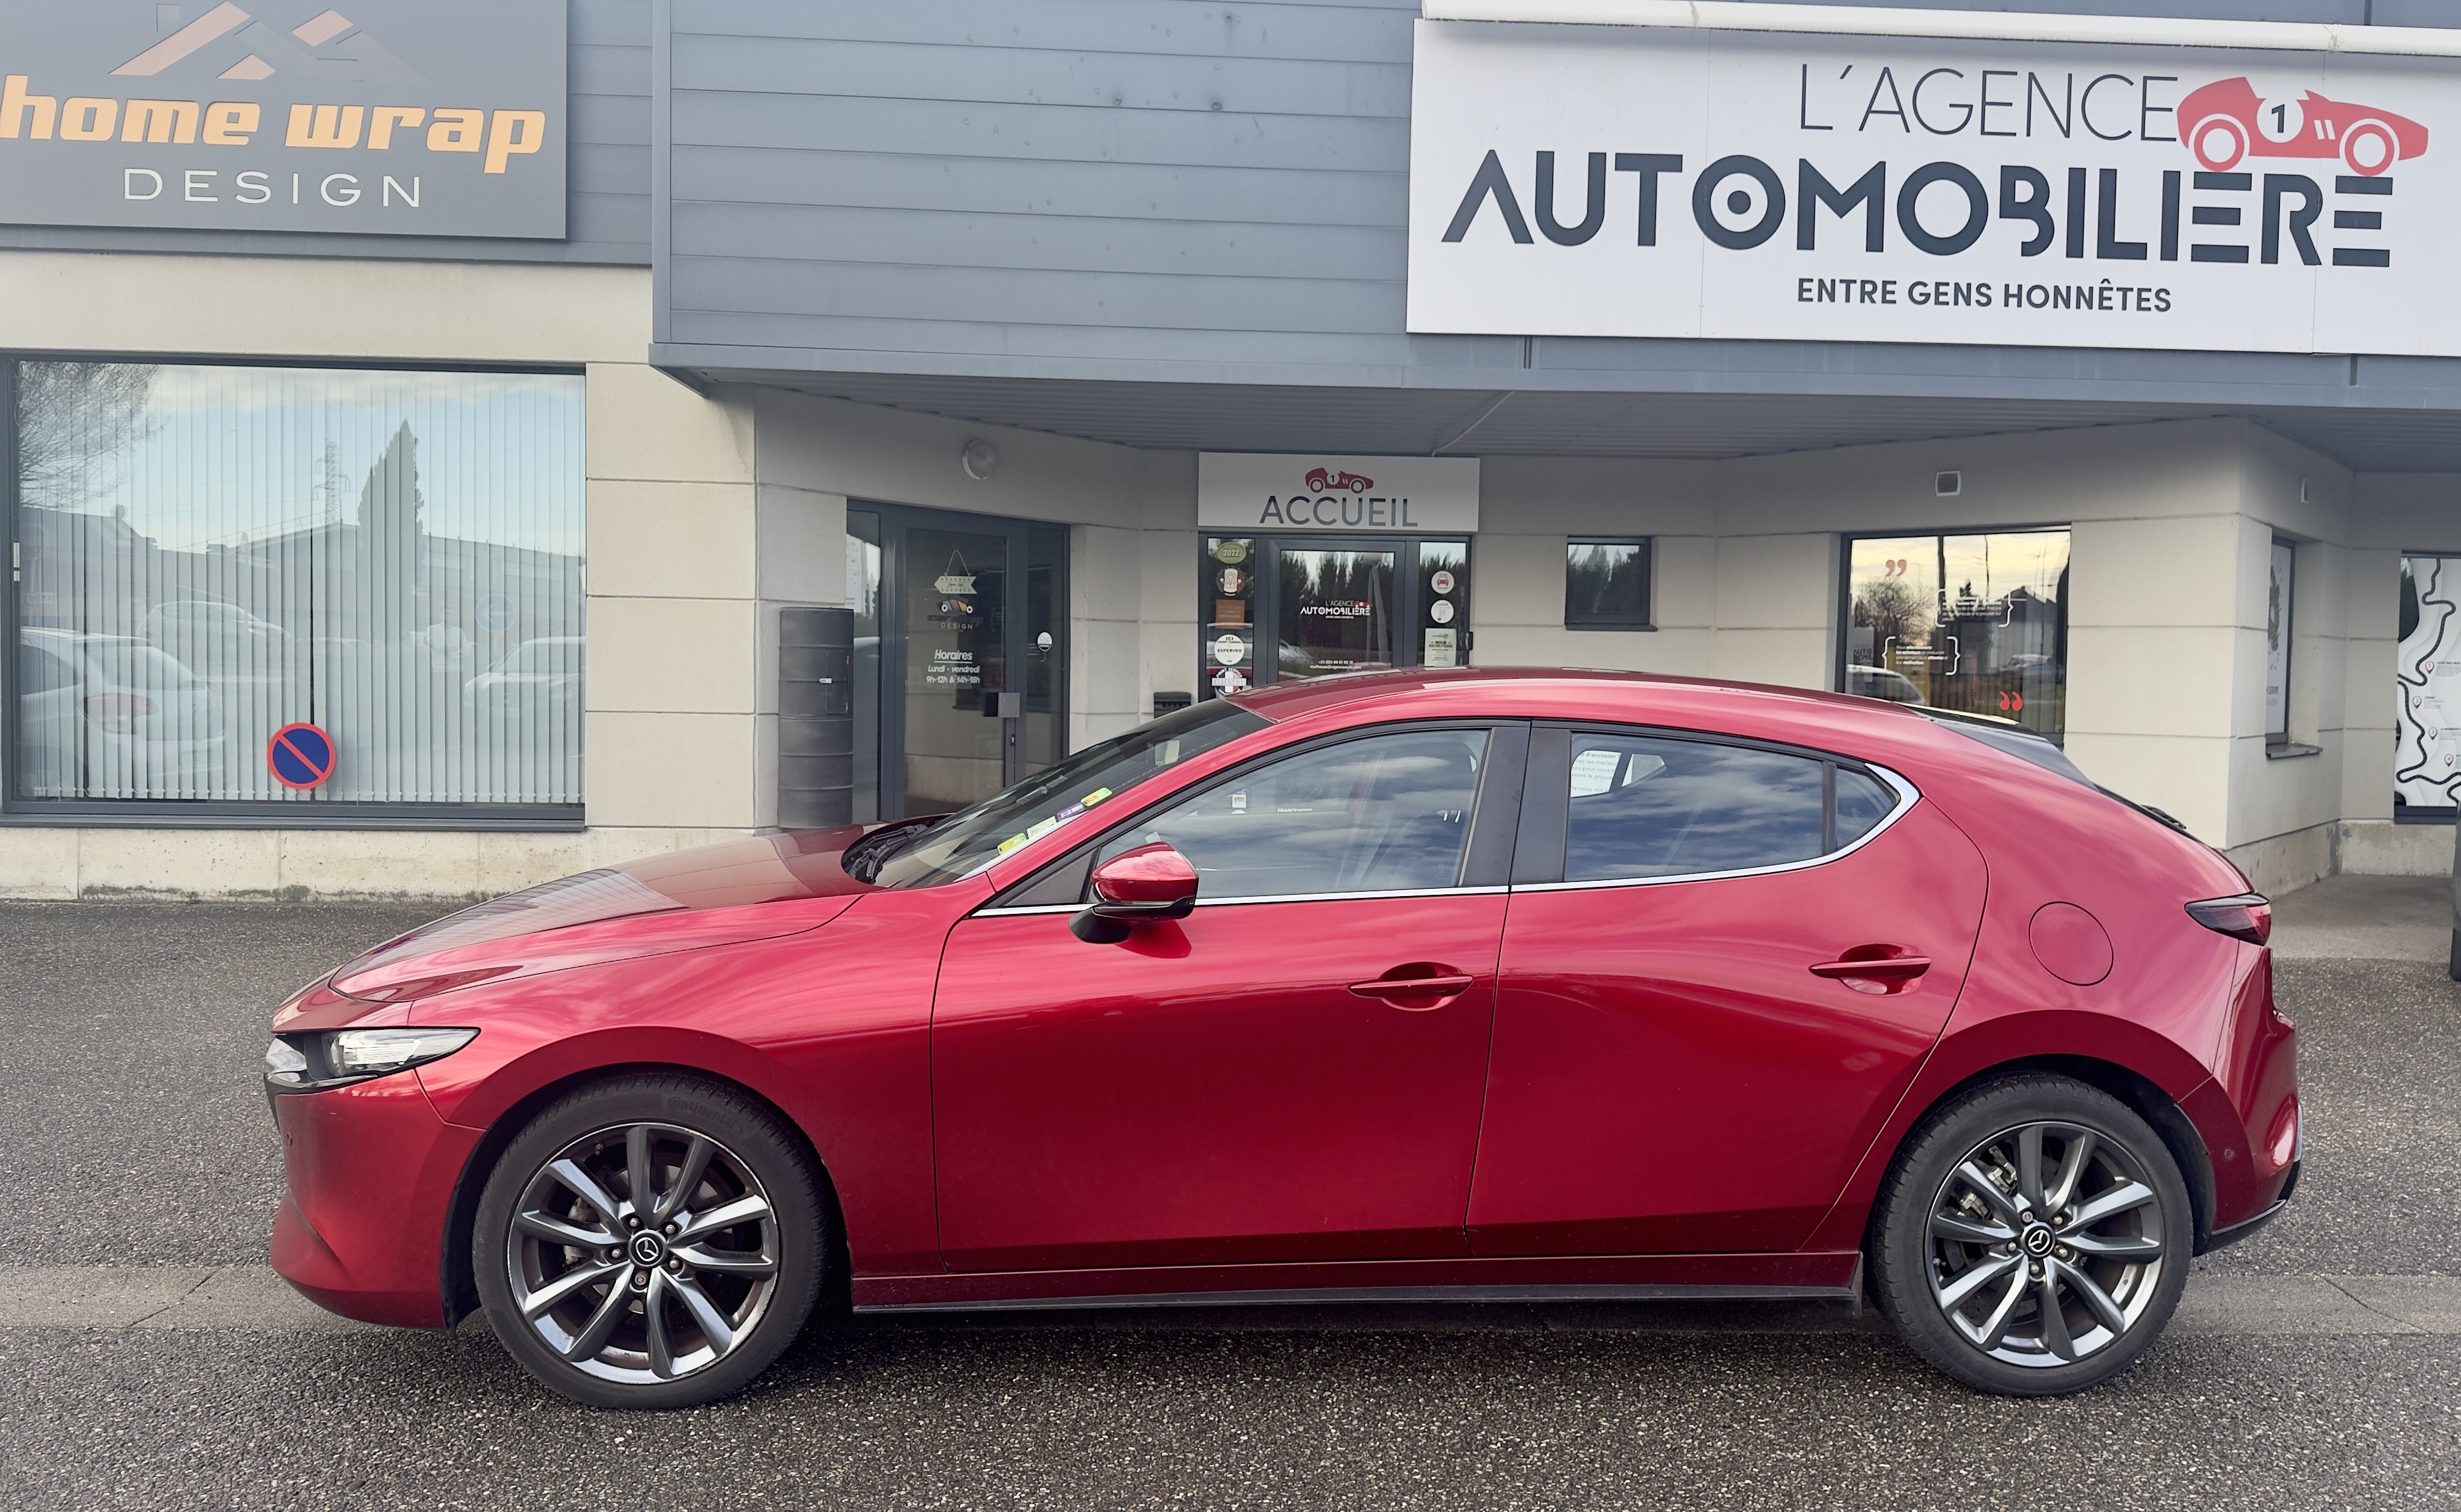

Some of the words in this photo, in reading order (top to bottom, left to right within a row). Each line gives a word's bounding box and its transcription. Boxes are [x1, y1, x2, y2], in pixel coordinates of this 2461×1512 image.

[1800, 63, 2179, 143] L'AGENCE
[2271, 103, 2287, 134] 1
[0, 73, 261, 146] home
[284, 103, 546, 175] wrap
[124, 168, 421, 208] DESIGN
[1440, 148, 2394, 269] AUTOMOBILIERE
[1797, 277, 1898, 305] ENTRE
[1907, 280, 1994, 308] GENS
[2003, 278, 2172, 313] HONNÊTES
[1259, 495, 1418, 527] ACCUEIL
[1300, 606, 1371, 616] AUTOMOBILIERE
[927, 665, 945, 673] Lundi
[952, 665, 980, 673] vendredi
[934, 649, 973, 660] Horaires
